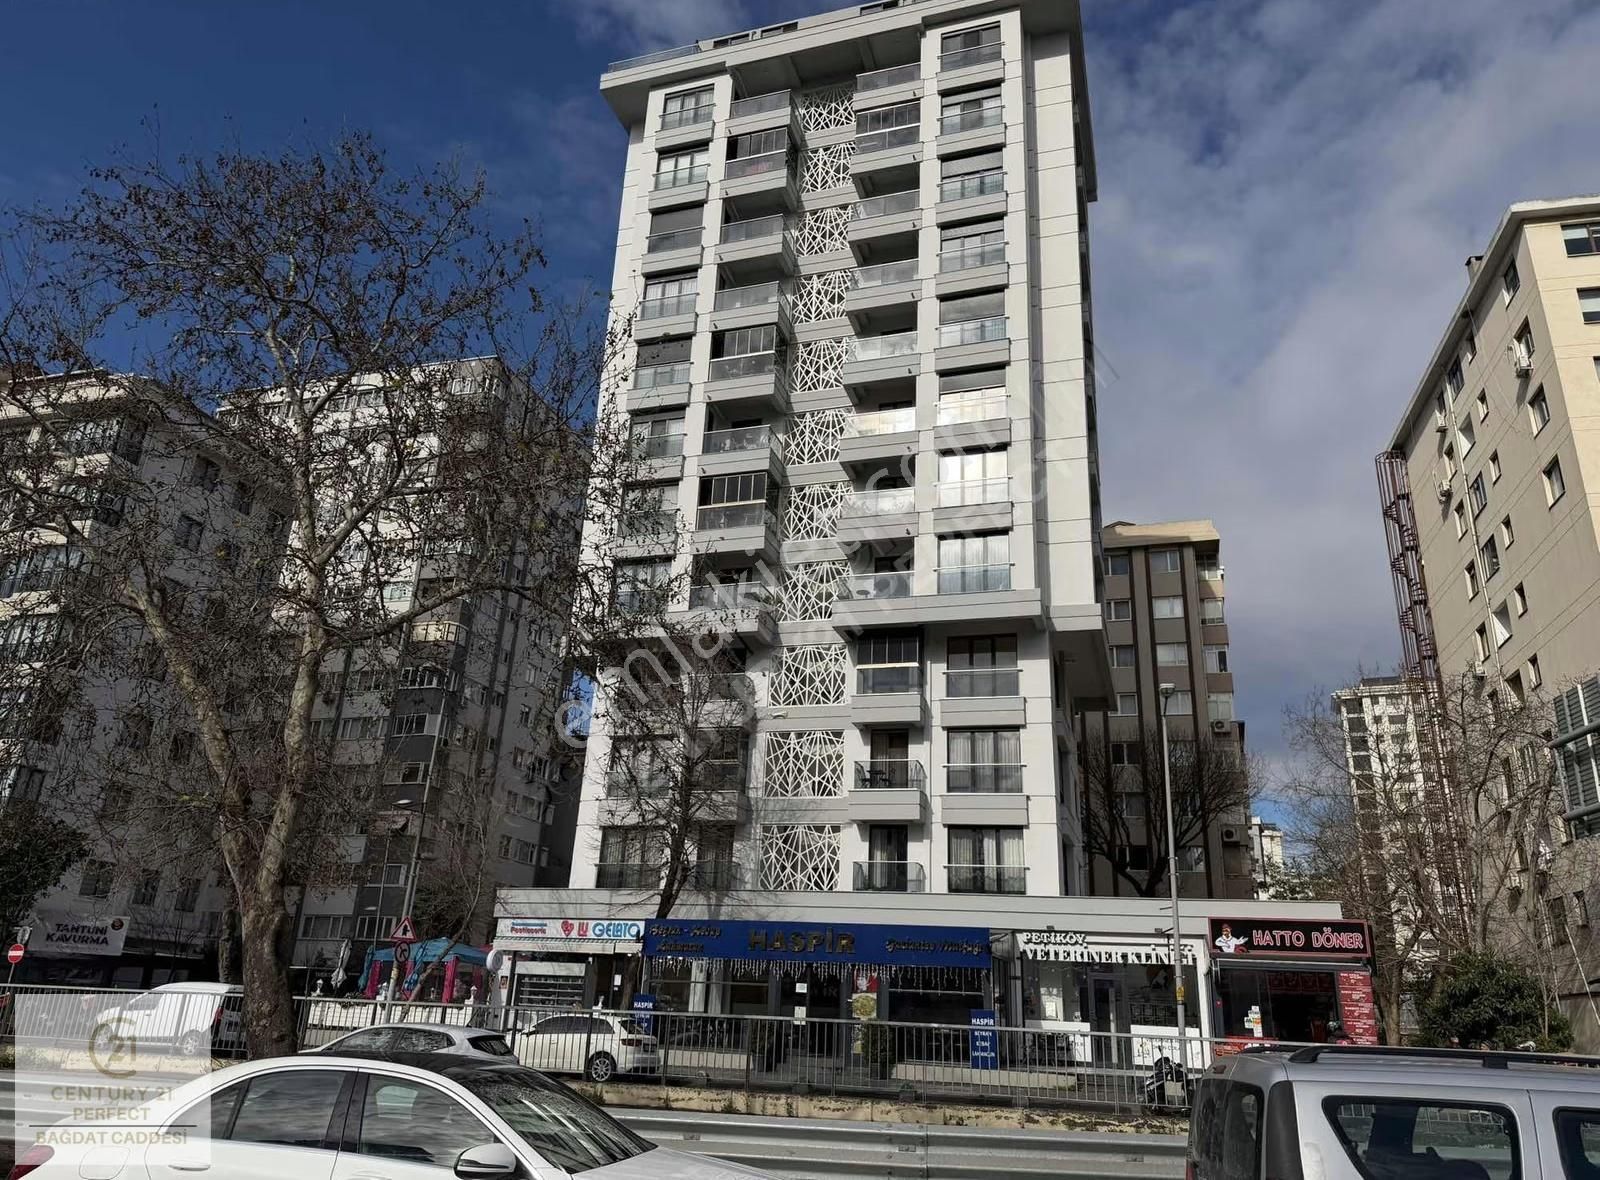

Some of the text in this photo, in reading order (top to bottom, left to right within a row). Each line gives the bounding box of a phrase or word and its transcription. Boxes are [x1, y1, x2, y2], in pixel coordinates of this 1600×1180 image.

[592, 921, 641, 938] GELATO
[46, 933, 109, 945] KAVURMA
[1023, 931, 1086, 944] PETİKÖY
[1253, 927, 1363, 949] HATTO DÖNER
[1024, 944, 1124, 963] VETERİNER
[971, 1018, 994, 1026] HASPİR
